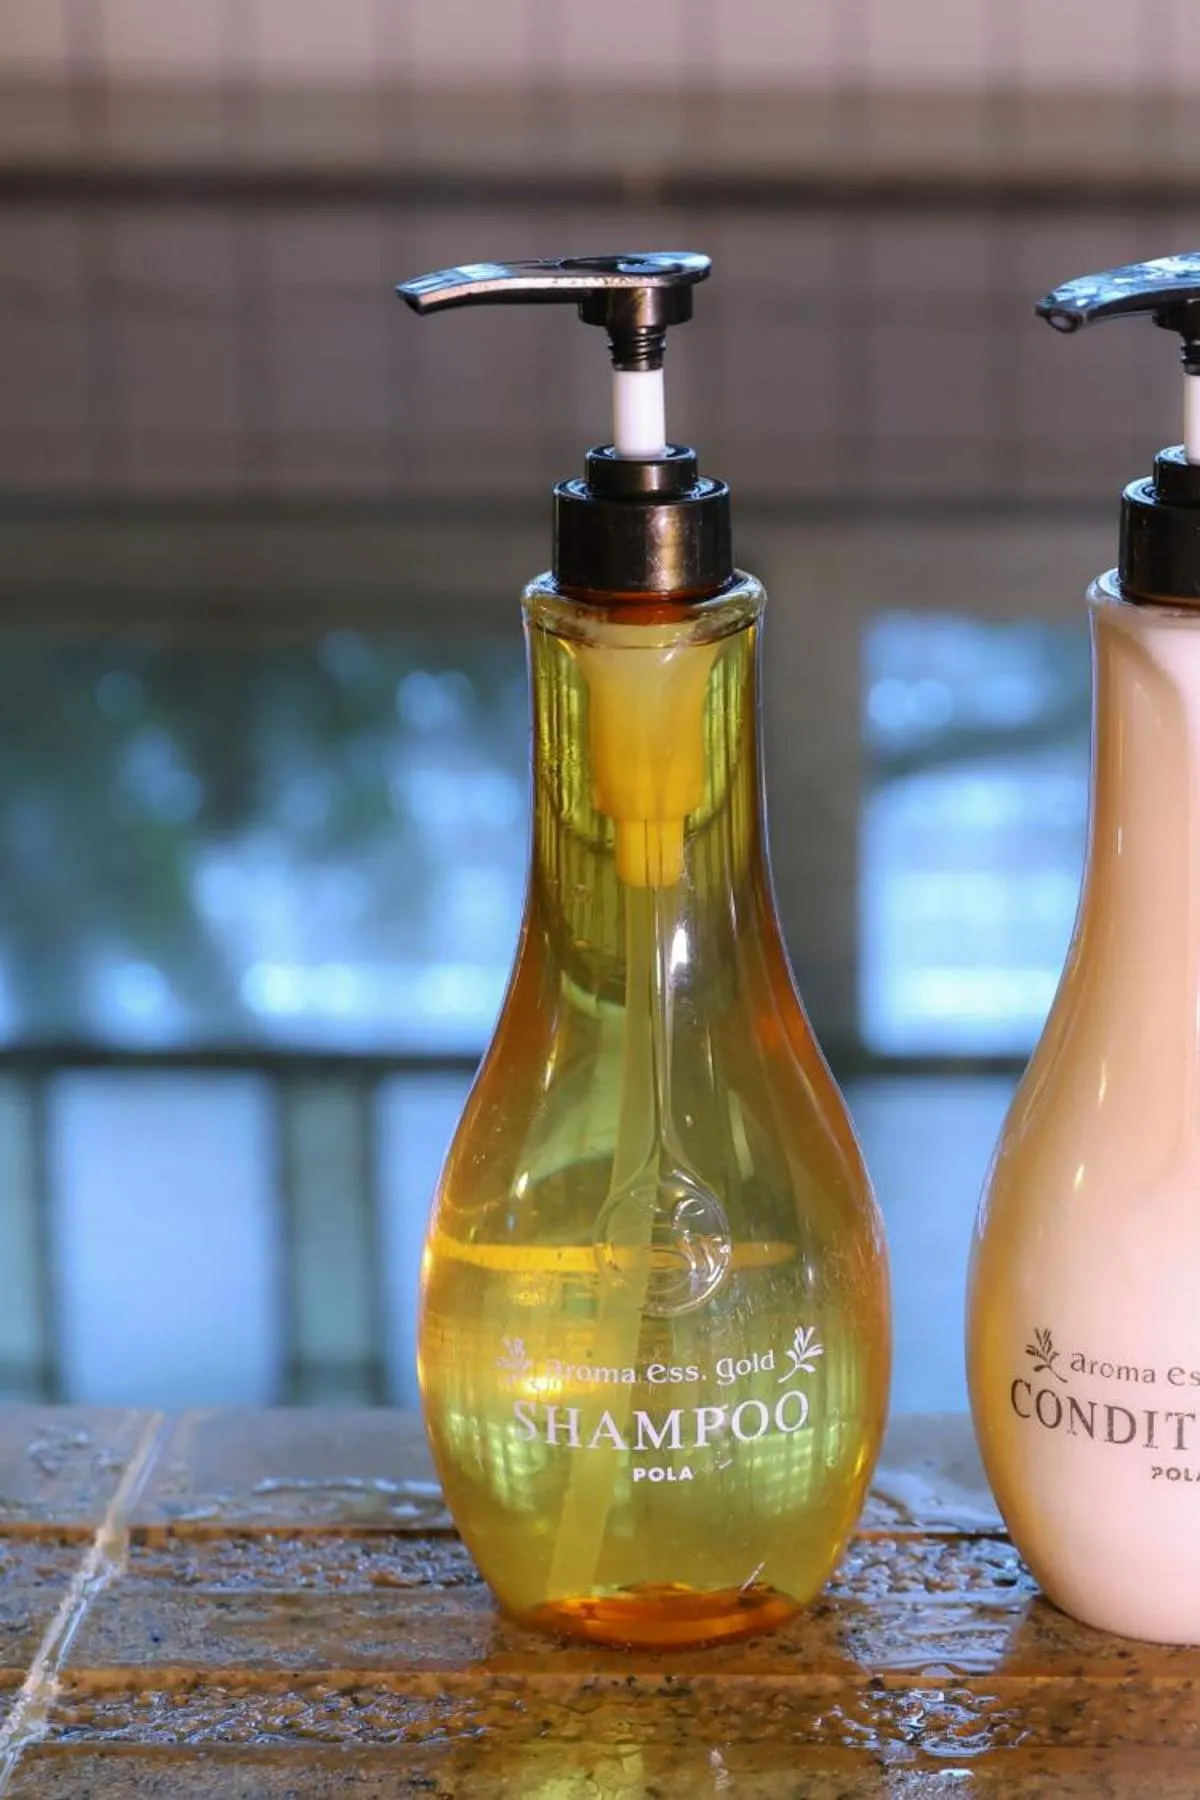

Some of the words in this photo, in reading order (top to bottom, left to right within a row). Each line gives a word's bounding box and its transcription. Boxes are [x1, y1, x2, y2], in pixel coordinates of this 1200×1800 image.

[545, 1358, 637, 1384] aroma
[646, 1362, 708, 1384] ess.
[716, 1350, 775, 1386] gold
[1069, 1352, 1157, 1384] aroma
[513, 1390, 810, 1451] SHAMPOO
[632, 1466, 695, 1483] POLA
